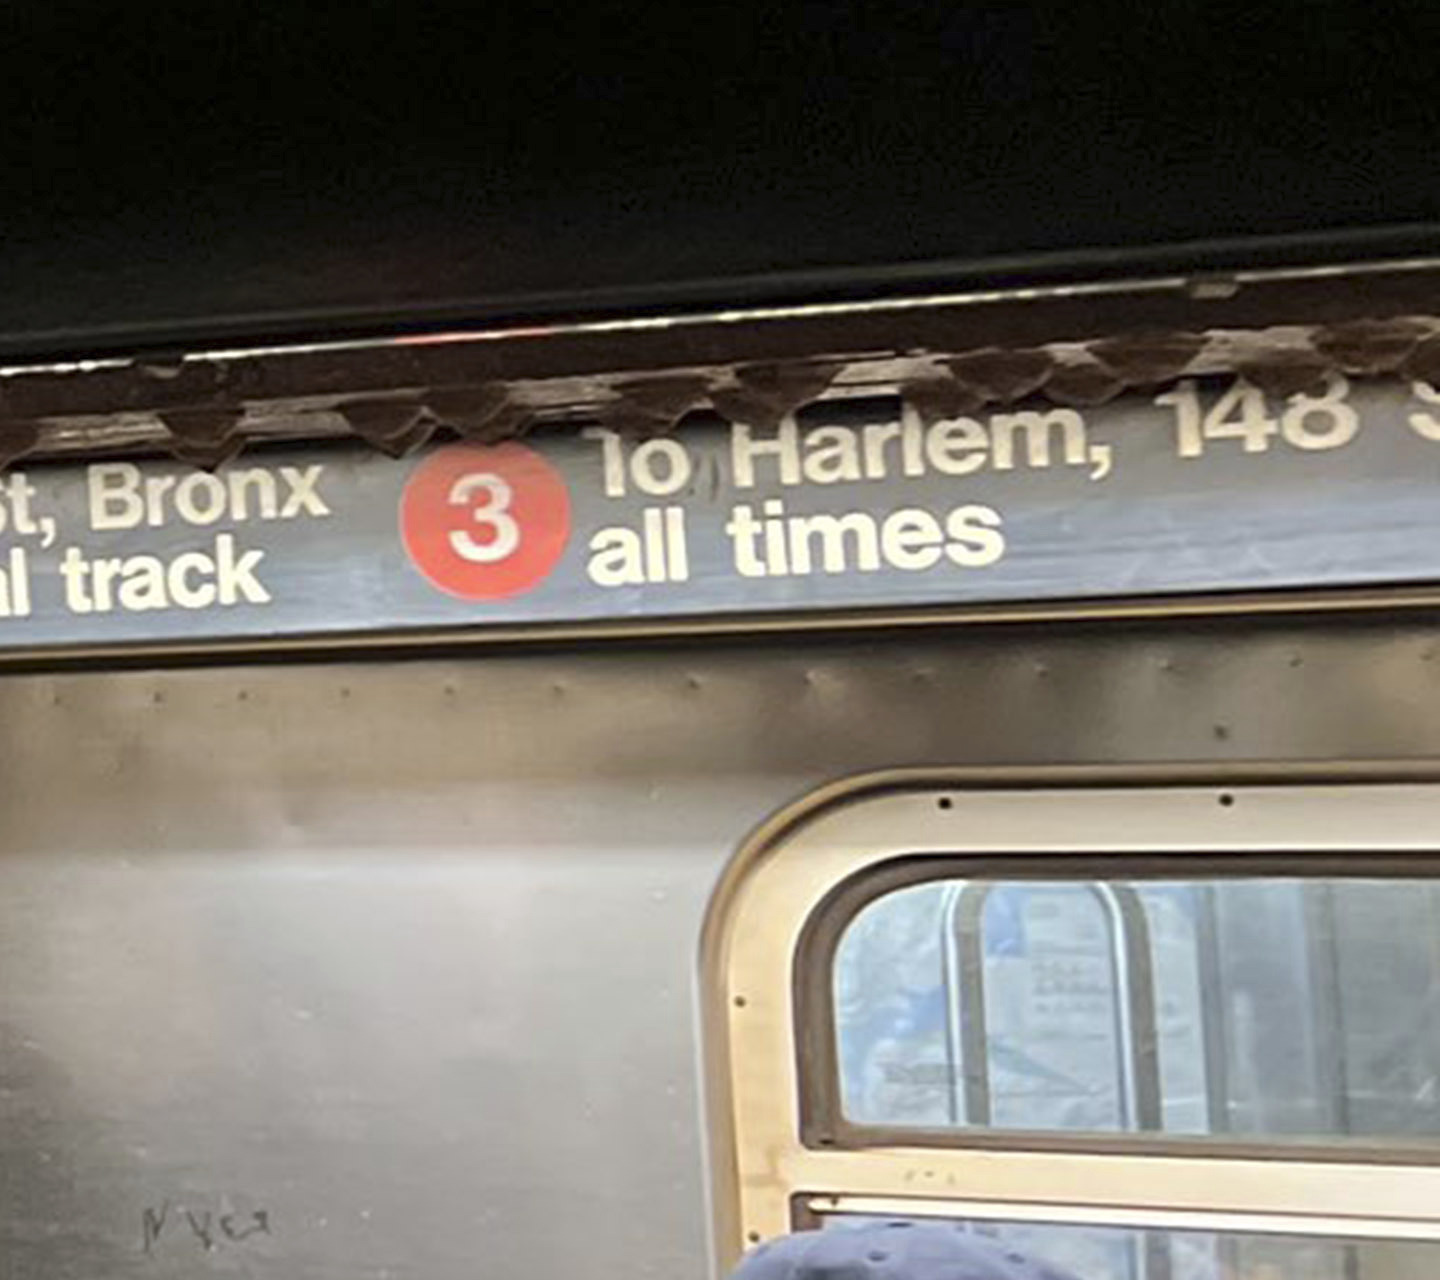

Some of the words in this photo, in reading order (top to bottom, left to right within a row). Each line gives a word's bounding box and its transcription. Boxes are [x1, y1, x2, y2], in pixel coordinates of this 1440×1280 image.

[586, 426, 693, 498] To
[732, 396, 1114, 489] Harlem,
[1154, 371, 1360, 457] 148
[87, 461, 331, 531] Bronx
[447, 472, 523, 565] 3
[587, 506, 689, 588] all
[726, 498, 1007, 578] times
[59, 534, 272, 614] track
